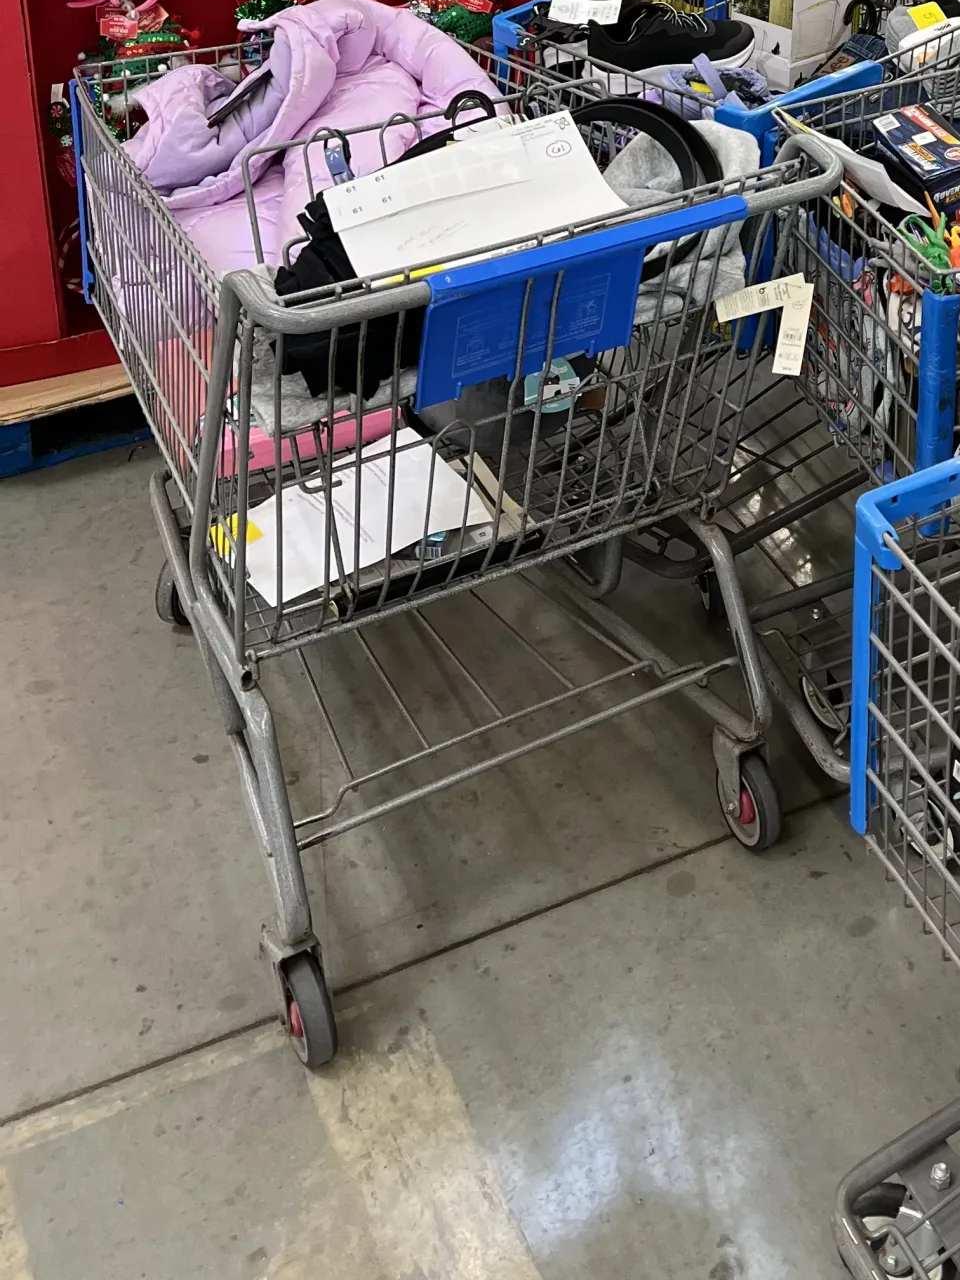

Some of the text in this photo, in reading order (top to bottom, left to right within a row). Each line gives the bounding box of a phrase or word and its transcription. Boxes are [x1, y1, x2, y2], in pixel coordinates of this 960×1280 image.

[821, 56, 850, 73] Lee
[375, 174, 385, 183] 61
[346, 185, 356, 194] 61
[382, 195, 392, 204] 61
[352, 206, 363, 214] 61
